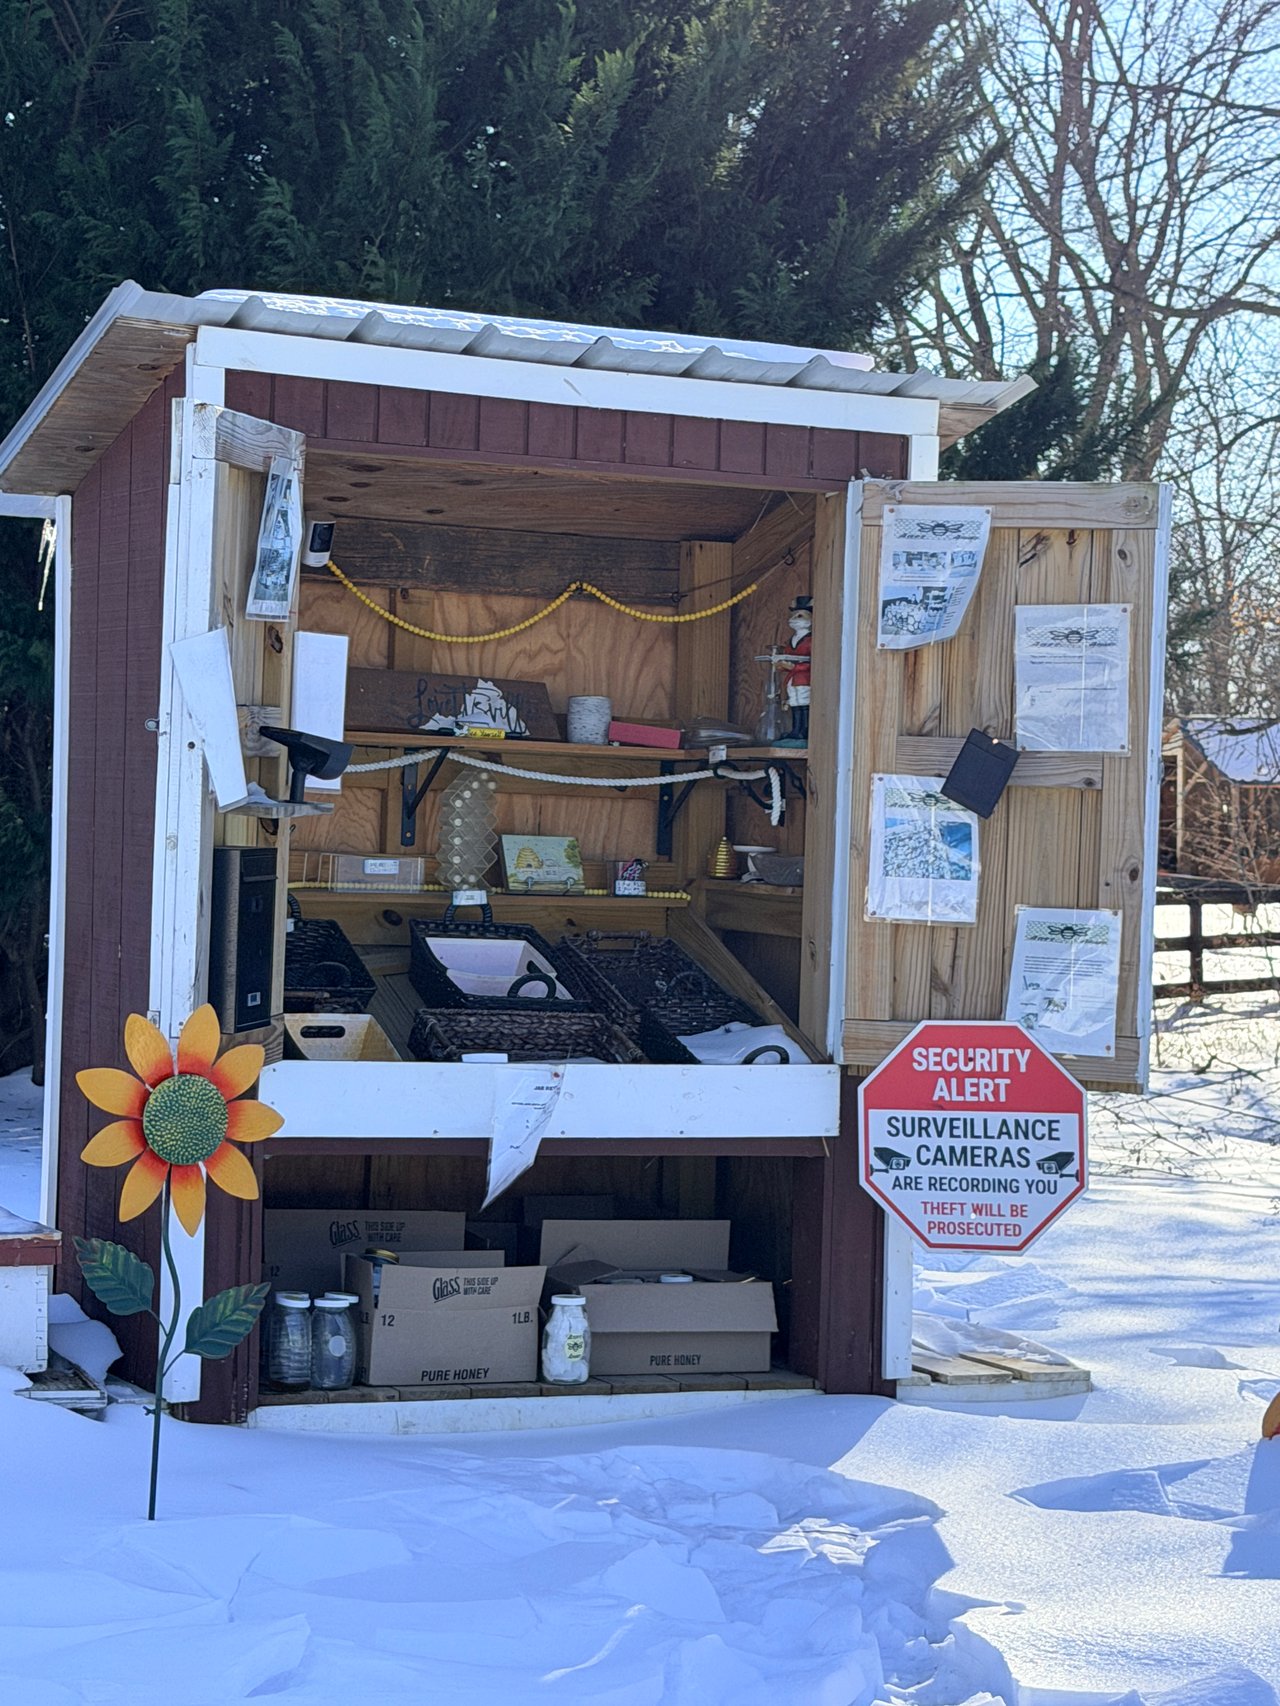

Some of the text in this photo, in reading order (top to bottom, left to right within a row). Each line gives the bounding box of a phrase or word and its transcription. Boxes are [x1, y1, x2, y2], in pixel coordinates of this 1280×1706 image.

[912, 1047, 1032, 1073] SECURITY
[932, 1077, 1011, 1103] ALERT
[886, 1116, 1061, 1141] SURVEILLANCE
[916, 1144, 1031, 1169] CAMERAS
[892, 1175, 1058, 1195] ARE RECORDING YOU
[921, 1201, 1029, 1218] THEFT WILL BE
[927, 1221, 1022, 1237] PROSECUTED
[463, 1276, 499, 1287] THIS SIDE UP
[463, 1286, 492, 1296] WITH CARE
[381, 1314, 396, 1327] 12
[649, 1353, 702, 1366] PURE HONEY
[421, 1367, 490, 1382] PURE HONEY
